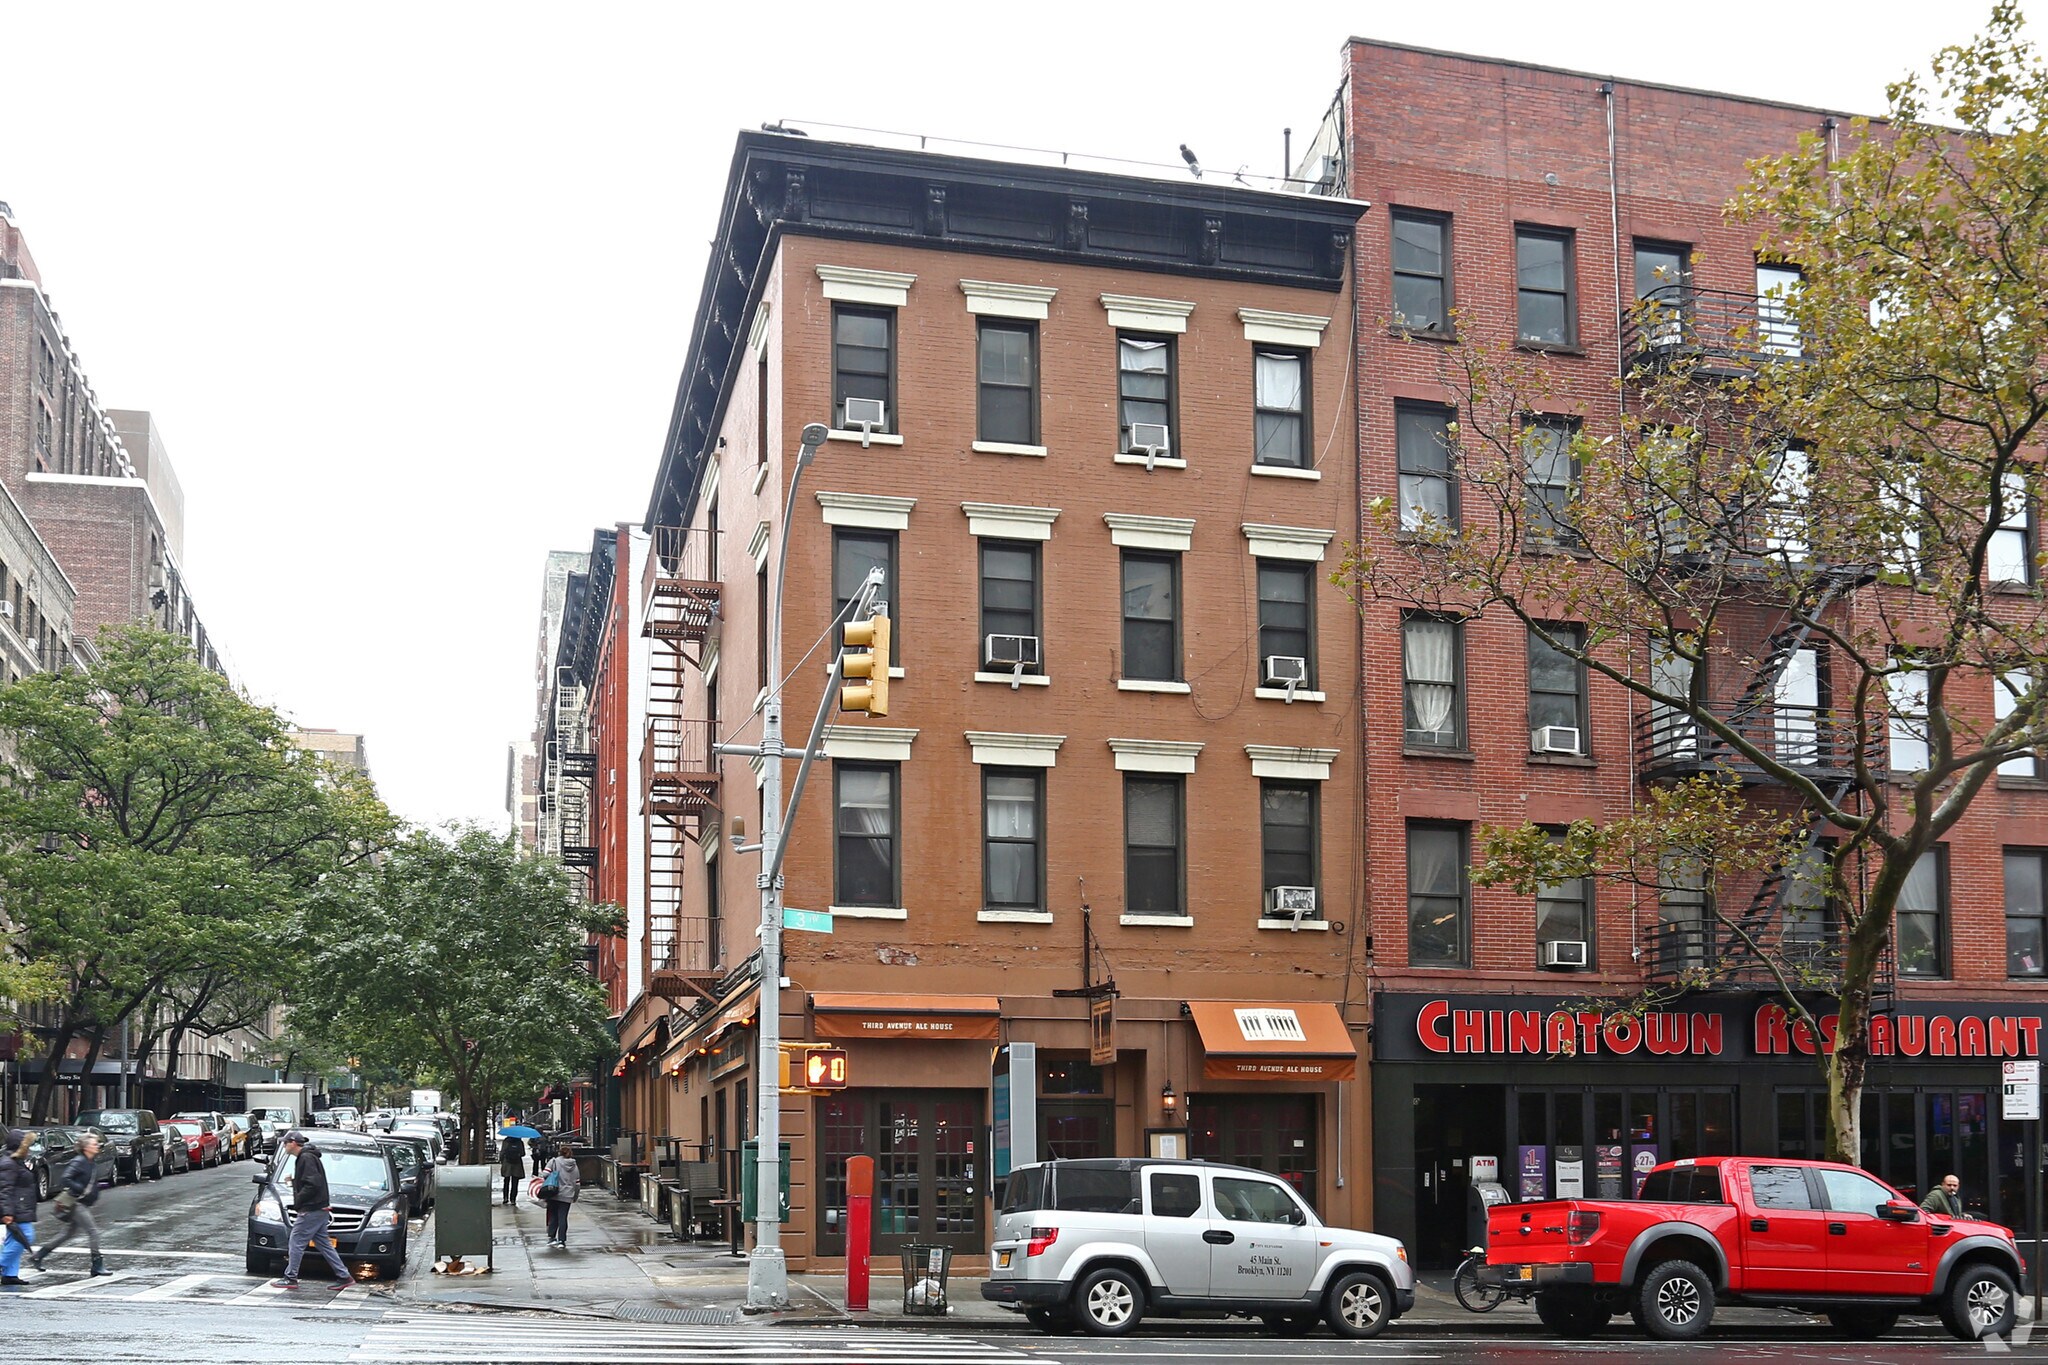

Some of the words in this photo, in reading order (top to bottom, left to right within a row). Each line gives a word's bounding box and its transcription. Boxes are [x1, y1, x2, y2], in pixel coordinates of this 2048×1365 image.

[797, 912, 806, 927] 3
[887, 1022, 912, 1030] AVENUE
[916, 1022, 928, 1030] ALE
[1416, 1000, 1723, 1056] CHINATOWN
[1754, 1003, 2042, 1057] RESAURANT
[1259, 1065, 1284, 1073] AVENUE
[1250, 1255, 1257, 1264] 45
[1258, 1255, 1272, 1265] Main
[1273, 1256, 1281, 1265] St.
[1237, 1265, 1265, 1277] Brooklyn,
[1266, 1266, 1275, 1276] NY
[1276, 1267, 1292, 1276] 11201
